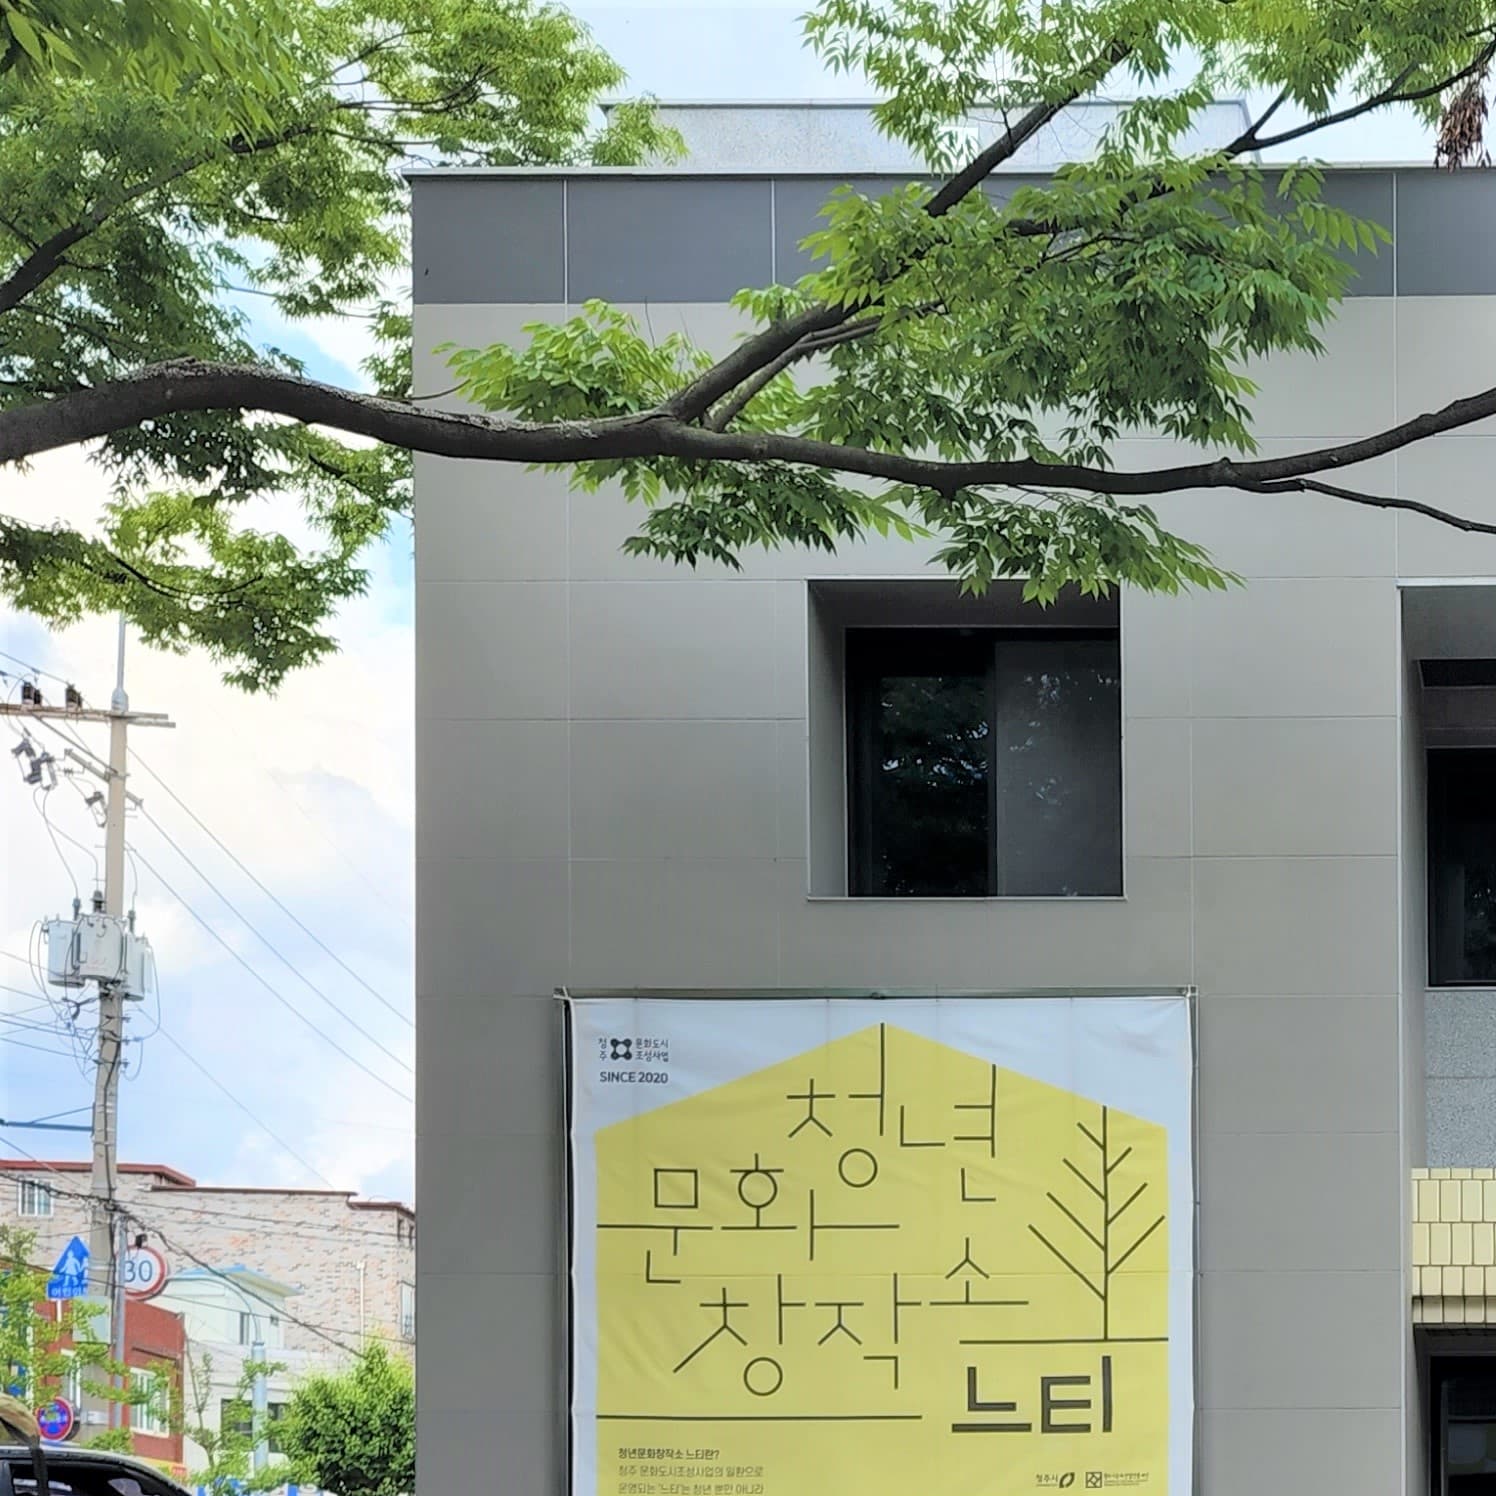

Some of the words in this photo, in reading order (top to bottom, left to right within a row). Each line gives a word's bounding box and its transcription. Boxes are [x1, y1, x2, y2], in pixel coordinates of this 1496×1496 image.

[636, 1037, 669, 1049] 문화도시
[635, 1050, 669, 1062] 조성사업
[599, 1071, 636, 1083] SINCE
[638, 1071, 669, 1084] 2020
[787, 1022, 997, 1202] 청년
[597, 1152, 901, 1285] 문화
[124, 1260, 153, 1282] 30
[673, 1236, 1029, 1397] 창작소
[952, 1354, 1113, 1435] 느티
[618, 1447, 683, 1460] 청년문화창작소
